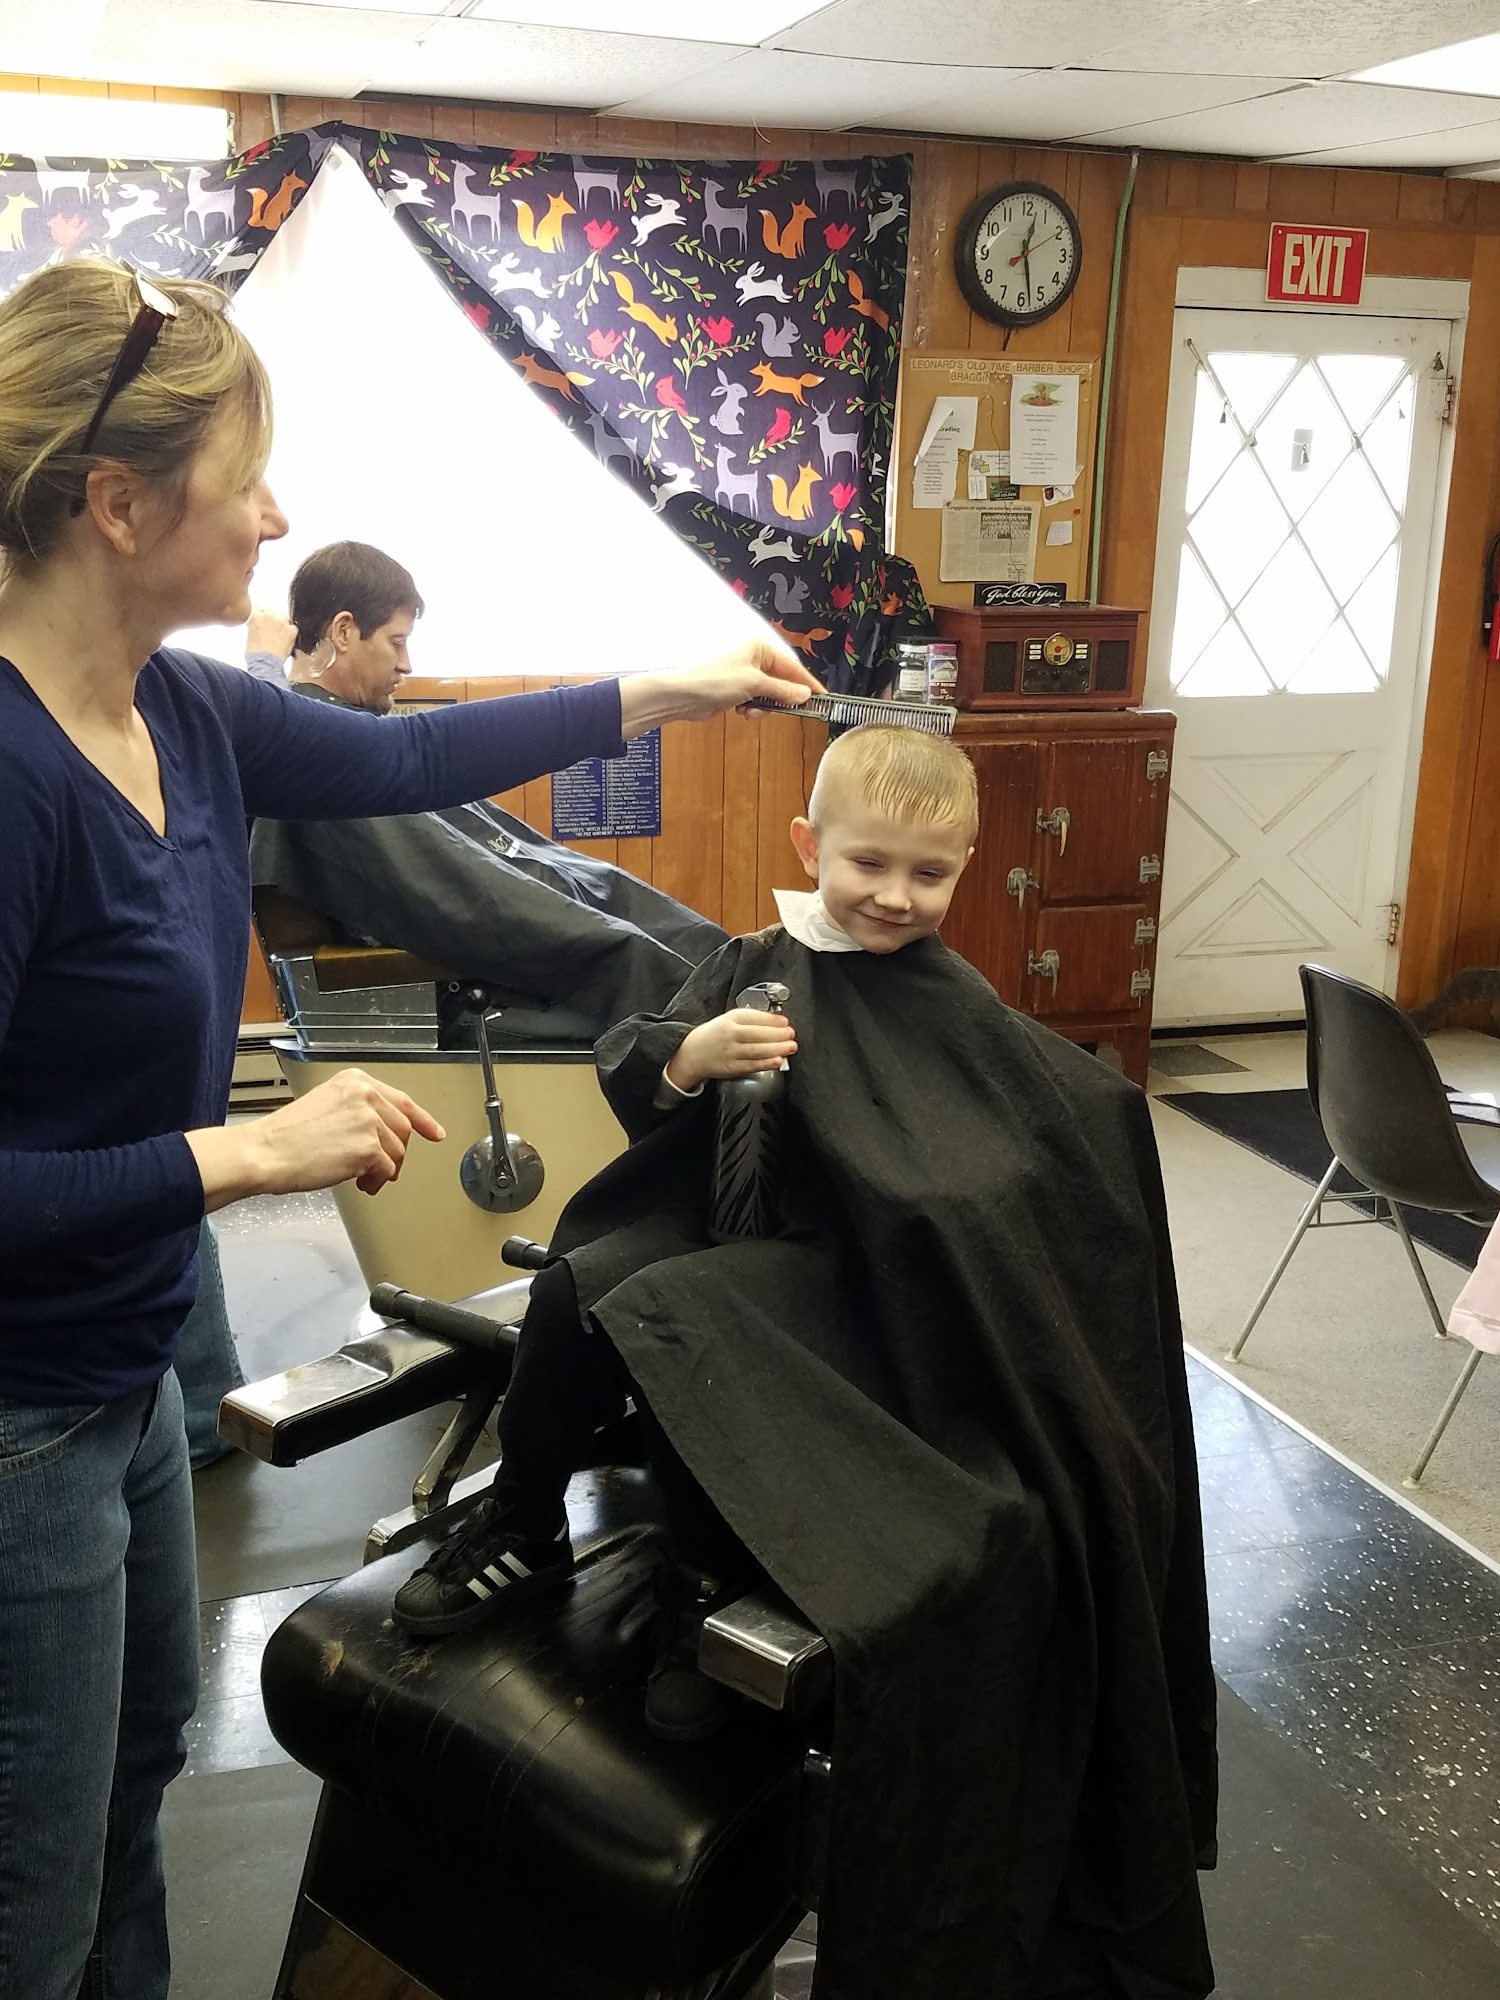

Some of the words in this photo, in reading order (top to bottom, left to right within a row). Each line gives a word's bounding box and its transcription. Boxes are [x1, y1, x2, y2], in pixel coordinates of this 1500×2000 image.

[1003, 207, 1012, 222] 11
[1022, 201, 1034, 216] 12
[987, 221, 1000, 236] 10
[1055, 225, 1063, 240] 2
[980, 245, 989, 260] 9
[1059, 248, 1067, 263] 3
[1281, 233, 1353, 297] EXIT
[984, 269, 993, 284] 8
[1052, 271, 1060, 286] 4
[1000, 285, 1008, 300] 7
[1017, 292, 1025, 307] 6
[1037, 286, 1045, 301] 5
[912, 360, 964, 369] LEONARD'S
[967, 361, 986, 371] OLD
[991, 362, 1011, 372] TIME
[1016, 363, 1053, 373] BARBER
[1058, 364, 1091, 373] SHOP'S
[1011, 585, 1035, 598] bless
